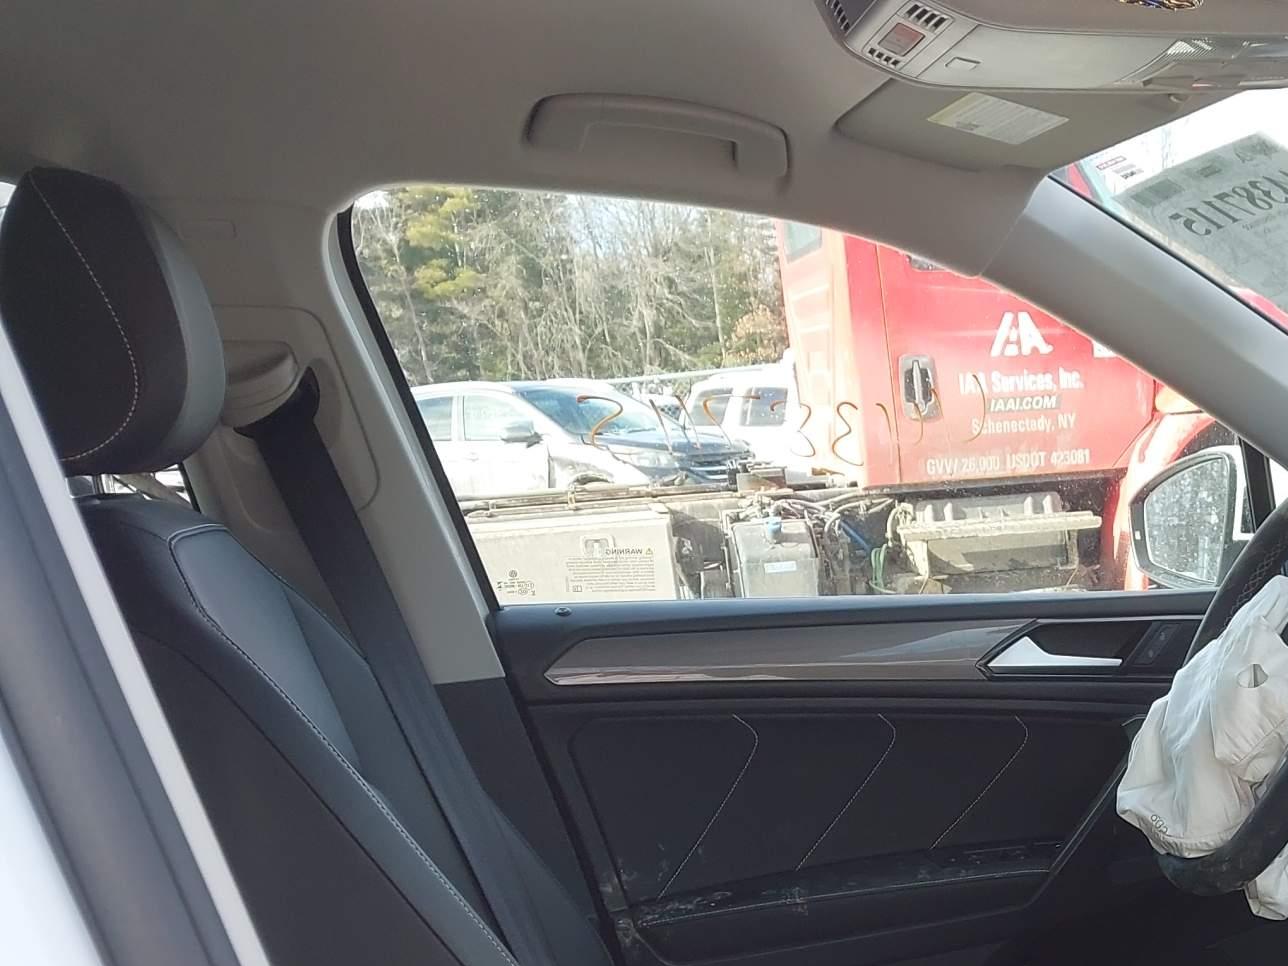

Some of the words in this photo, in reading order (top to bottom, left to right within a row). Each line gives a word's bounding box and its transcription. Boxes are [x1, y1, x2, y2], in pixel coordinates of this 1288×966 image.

[958, 371, 988, 396] IAA
[991, 369, 1057, 393] Services,
[1058, 367, 1084, 390] Inc.
[990, 396, 1057, 413] IAAI.COM
[971, 414, 1055, 435] Schenectady,
[1058, 412, 1077, 430] NY
[1006, 451, 1046, 470] USDOT
